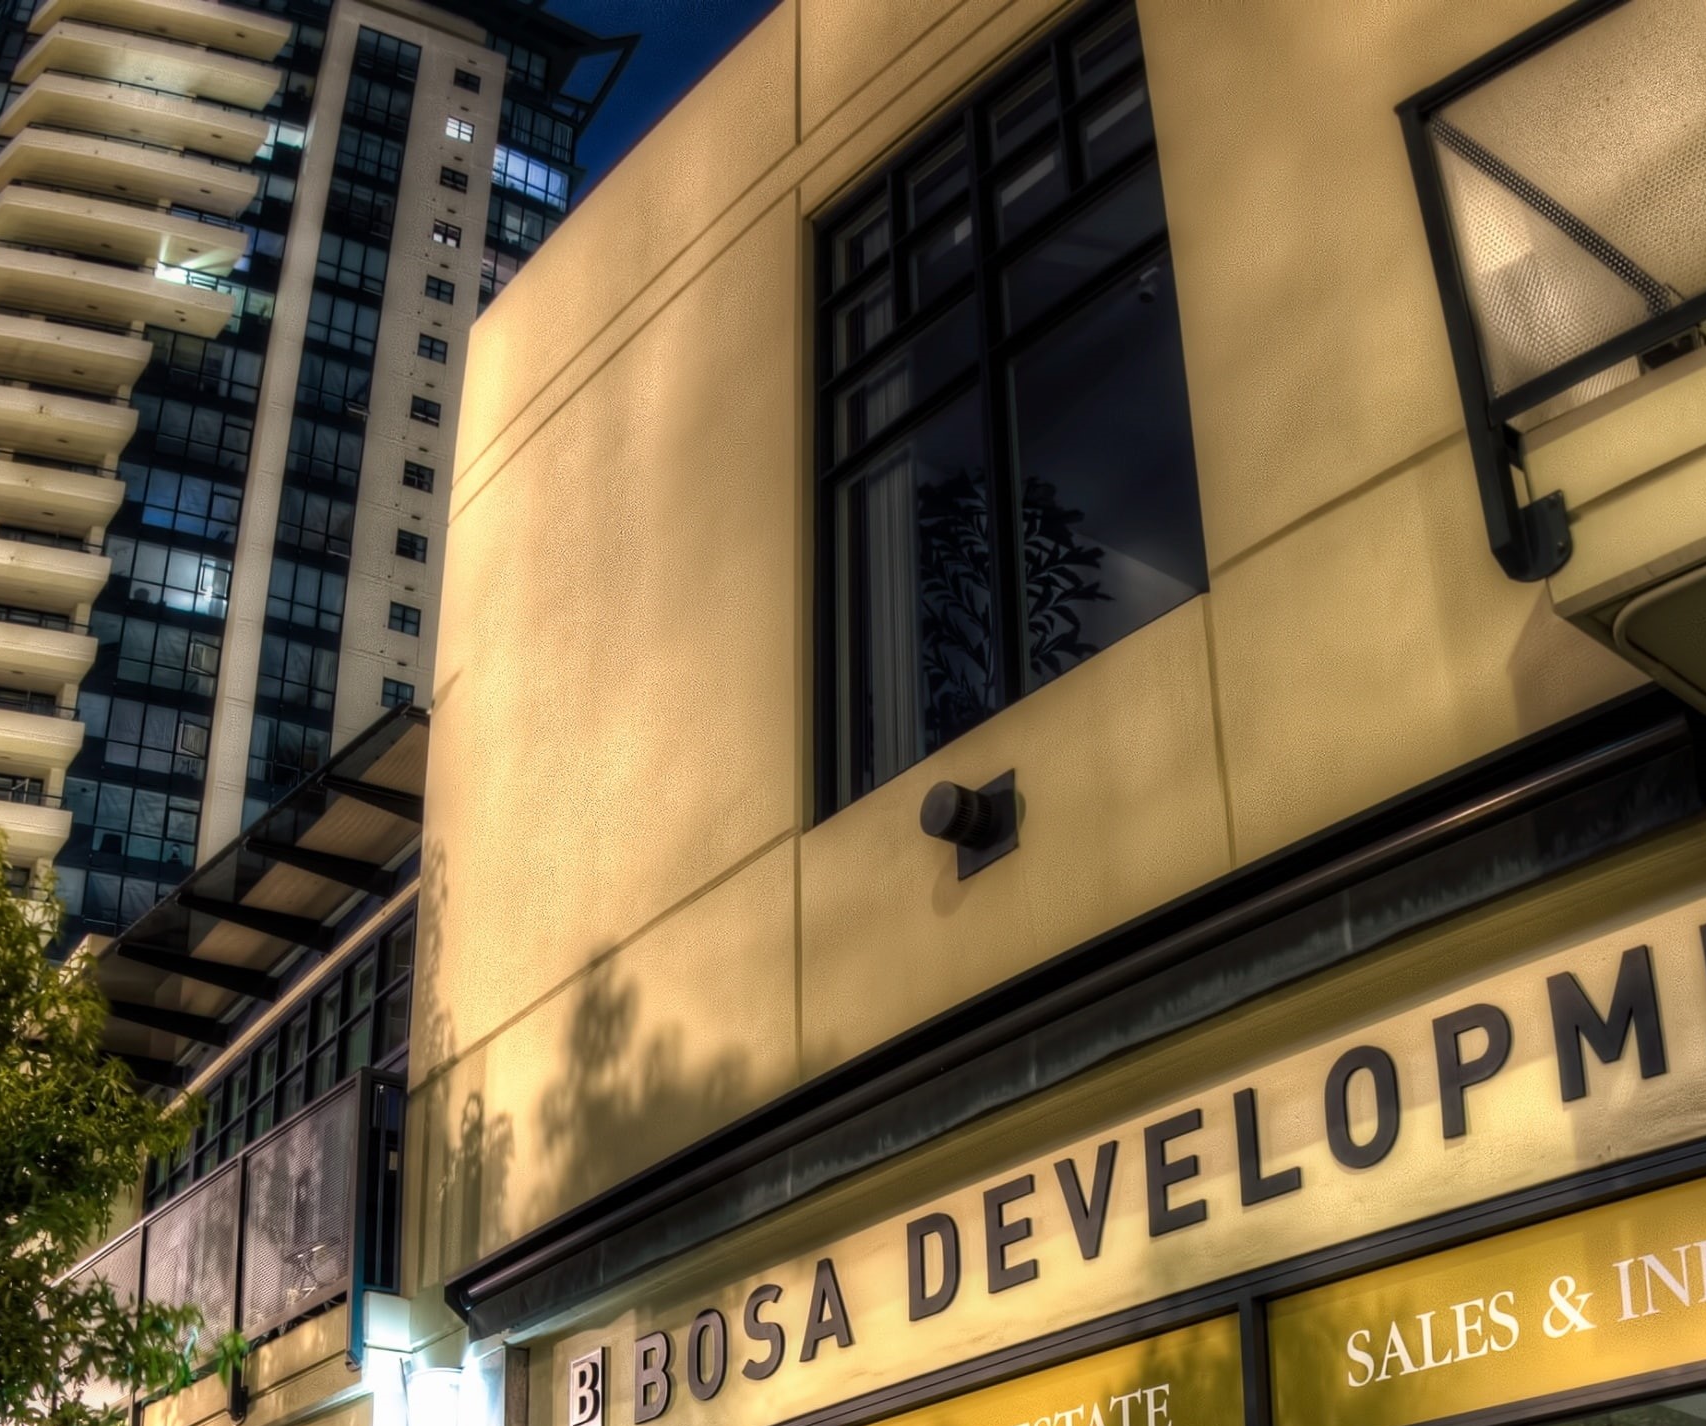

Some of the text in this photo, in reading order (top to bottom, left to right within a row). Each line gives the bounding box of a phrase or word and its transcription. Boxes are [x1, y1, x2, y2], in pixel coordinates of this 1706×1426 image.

[633, 1257, 855, 1425] BOSA
[1346, 1290, 1520, 1389] SALES
[1541, 1275, 1597, 1339] &
[571, 1361, 600, 1426] B
